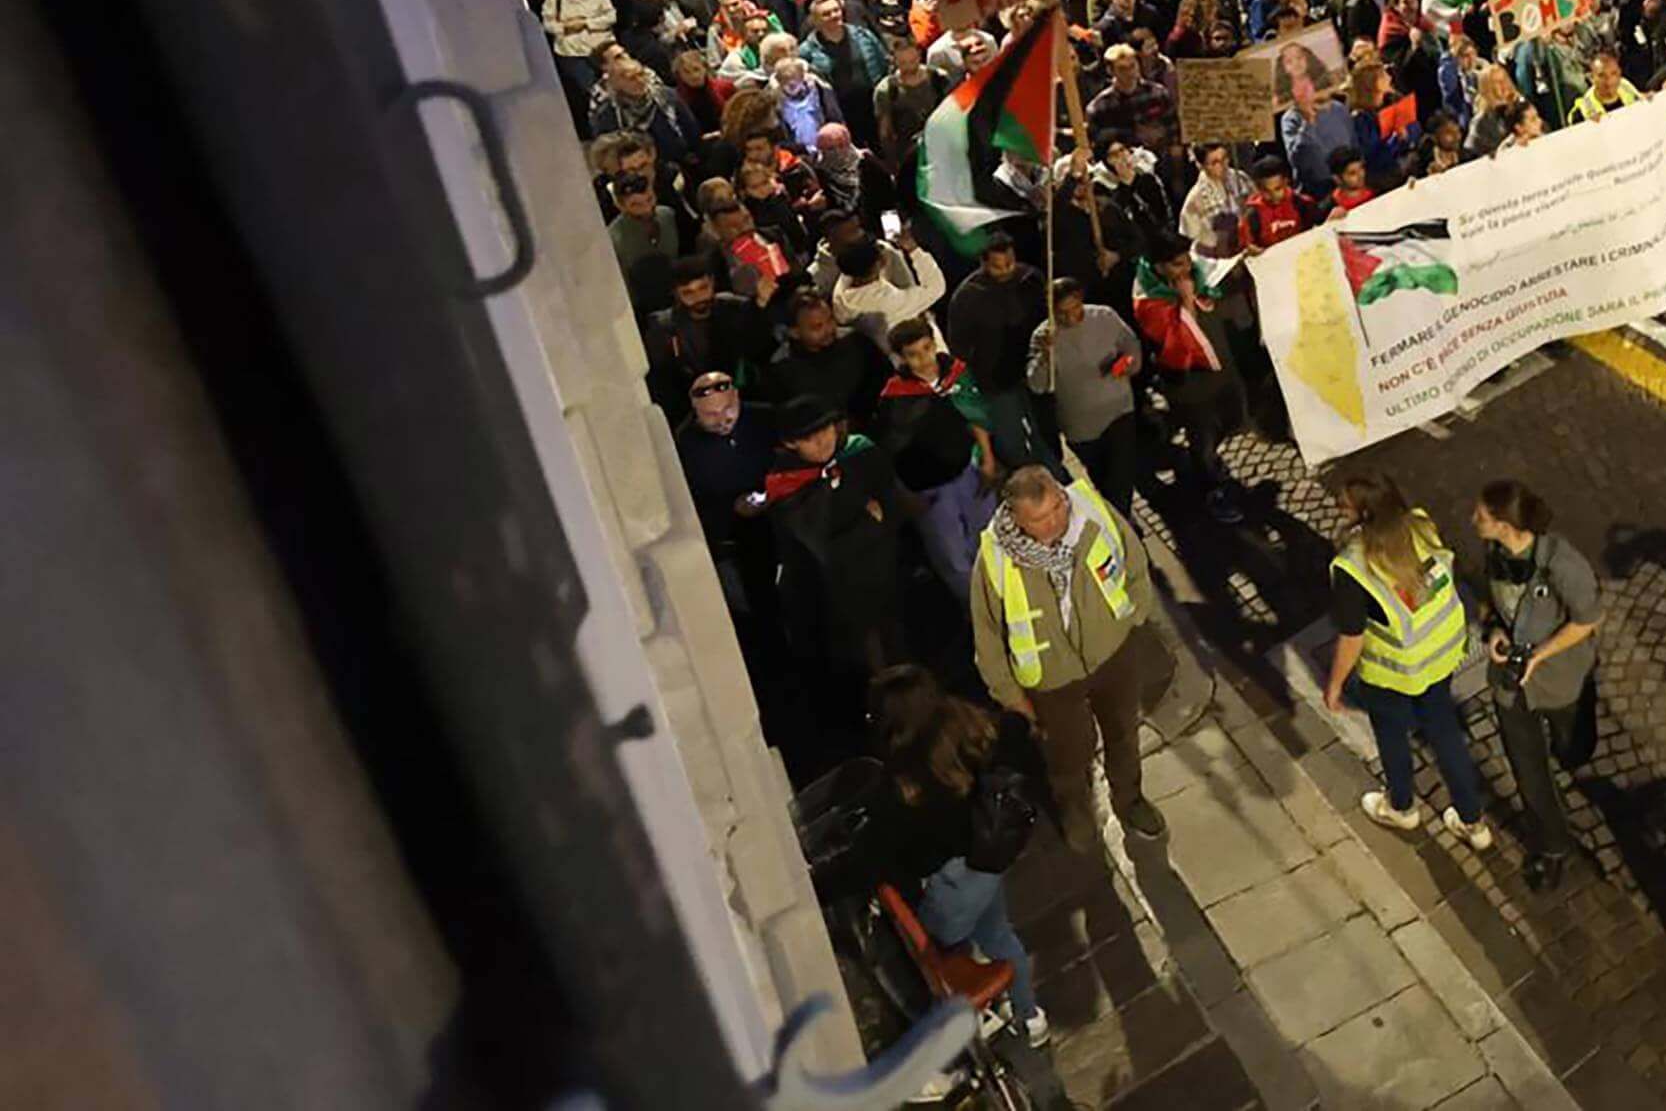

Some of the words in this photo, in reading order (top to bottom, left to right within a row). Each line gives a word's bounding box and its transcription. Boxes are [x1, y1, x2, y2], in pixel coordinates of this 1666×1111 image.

[1370, 326, 1438, 368] FERMARE
[1442, 284, 1517, 324] GENOCIDIO
[1378, 369, 1411, 393] NON
[1461, 318, 1503, 344] SENZA
[1385, 385, 1440, 417] ULTIMO
